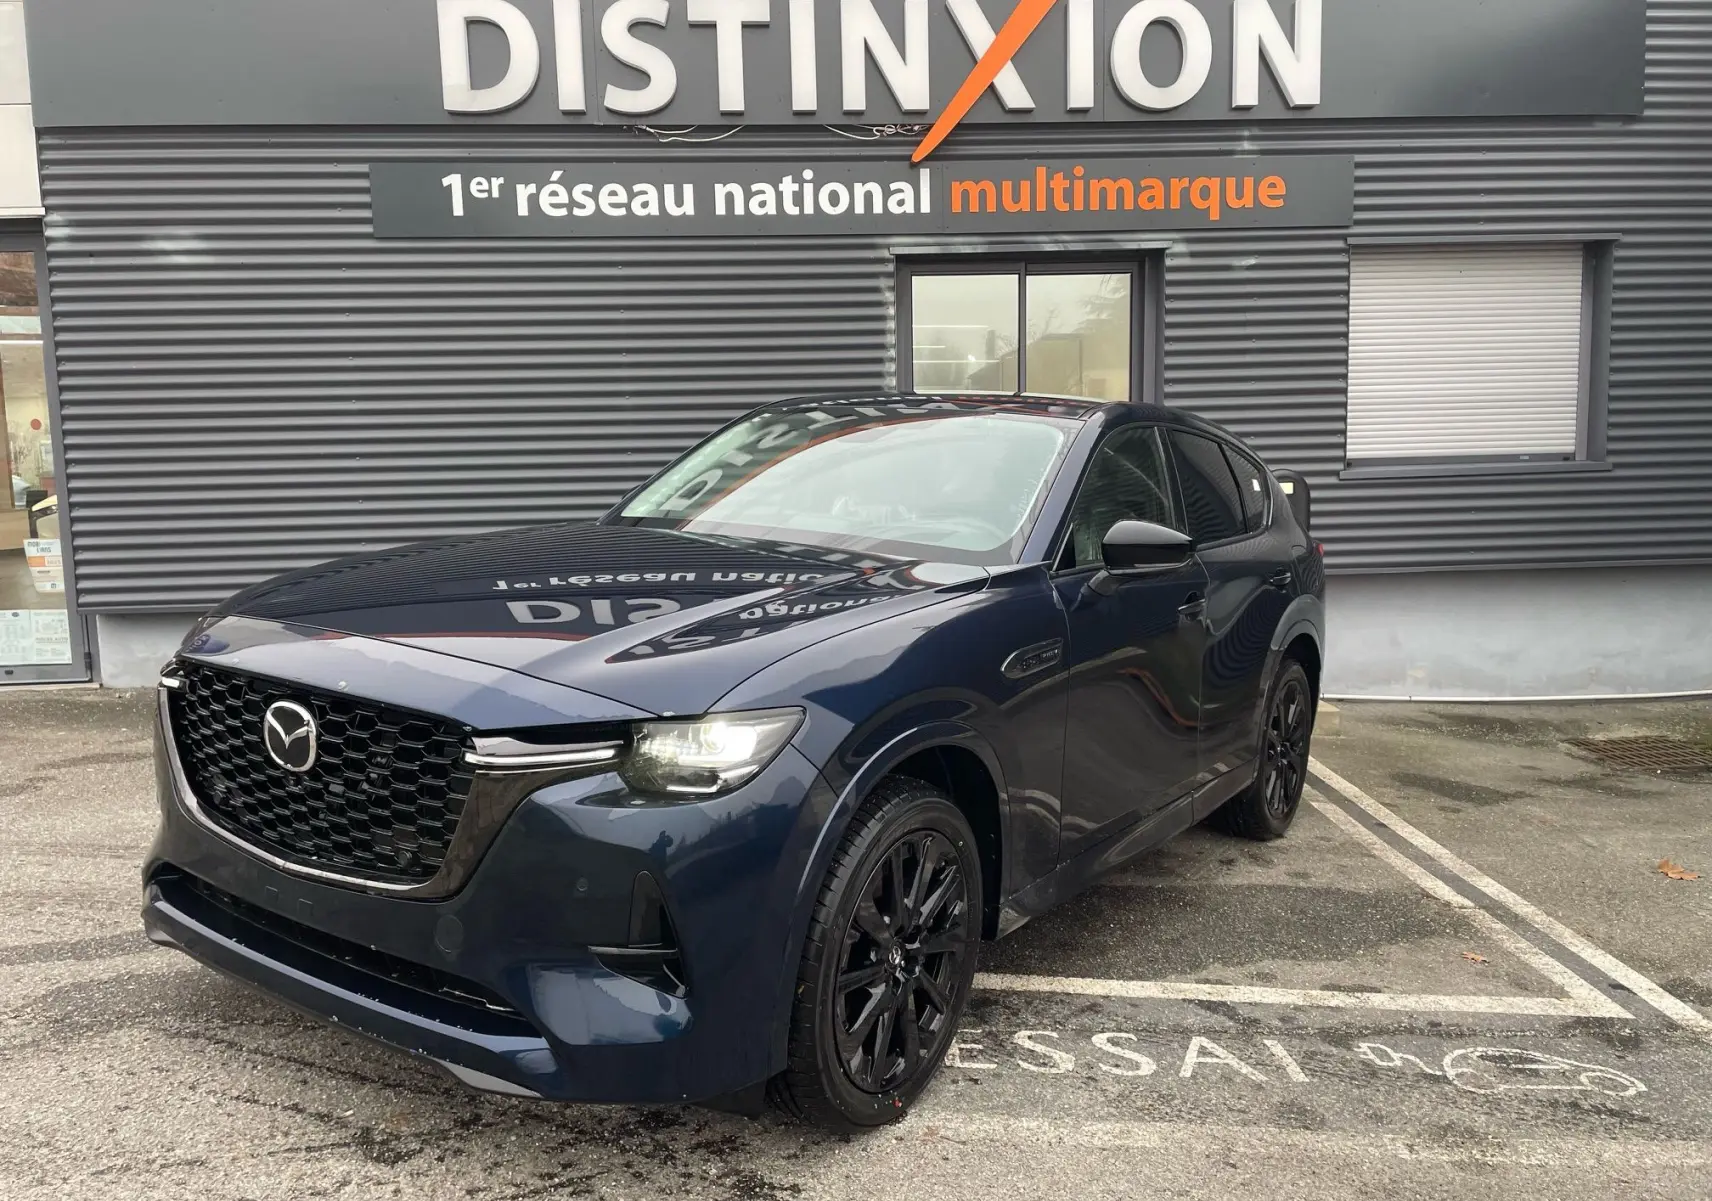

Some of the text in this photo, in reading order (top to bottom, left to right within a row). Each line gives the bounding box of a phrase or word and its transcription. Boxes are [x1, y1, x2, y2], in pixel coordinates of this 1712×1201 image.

[435, 0, 1323, 163] DISTINXION
[441, 165, 1287, 221] 1er réseau national multimarque
[944, 1029, 1310, 1083] ESSAI
